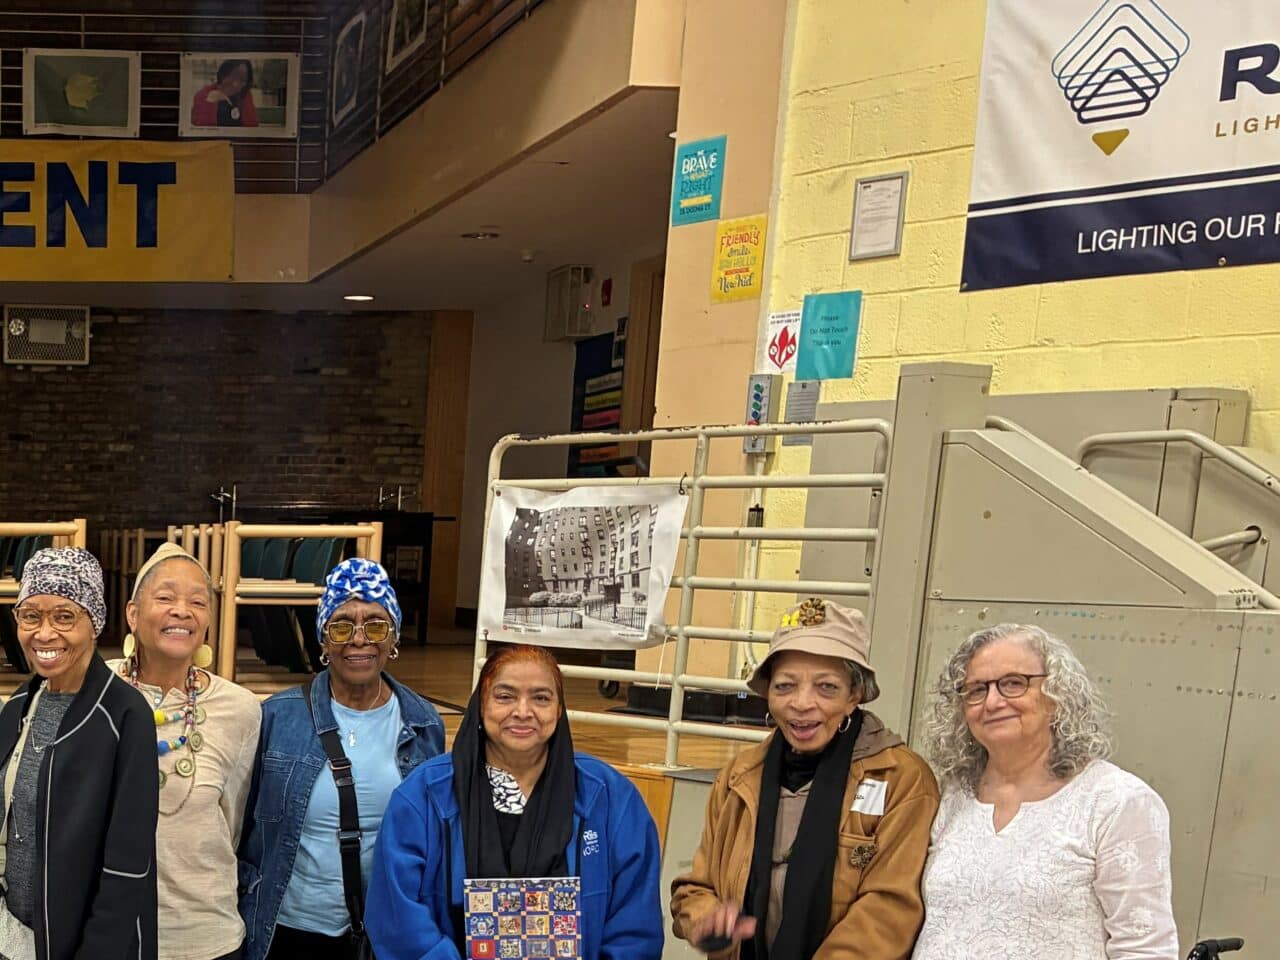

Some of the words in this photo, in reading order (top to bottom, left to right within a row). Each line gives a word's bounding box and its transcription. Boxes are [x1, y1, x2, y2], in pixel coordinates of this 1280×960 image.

[682, 152, 718, 175] BRAVE
[720, 231, 760, 253] FRIENDLY
[1077, 221, 1197, 254] LIGHTING
[1204, 214, 1266, 241] OUR
